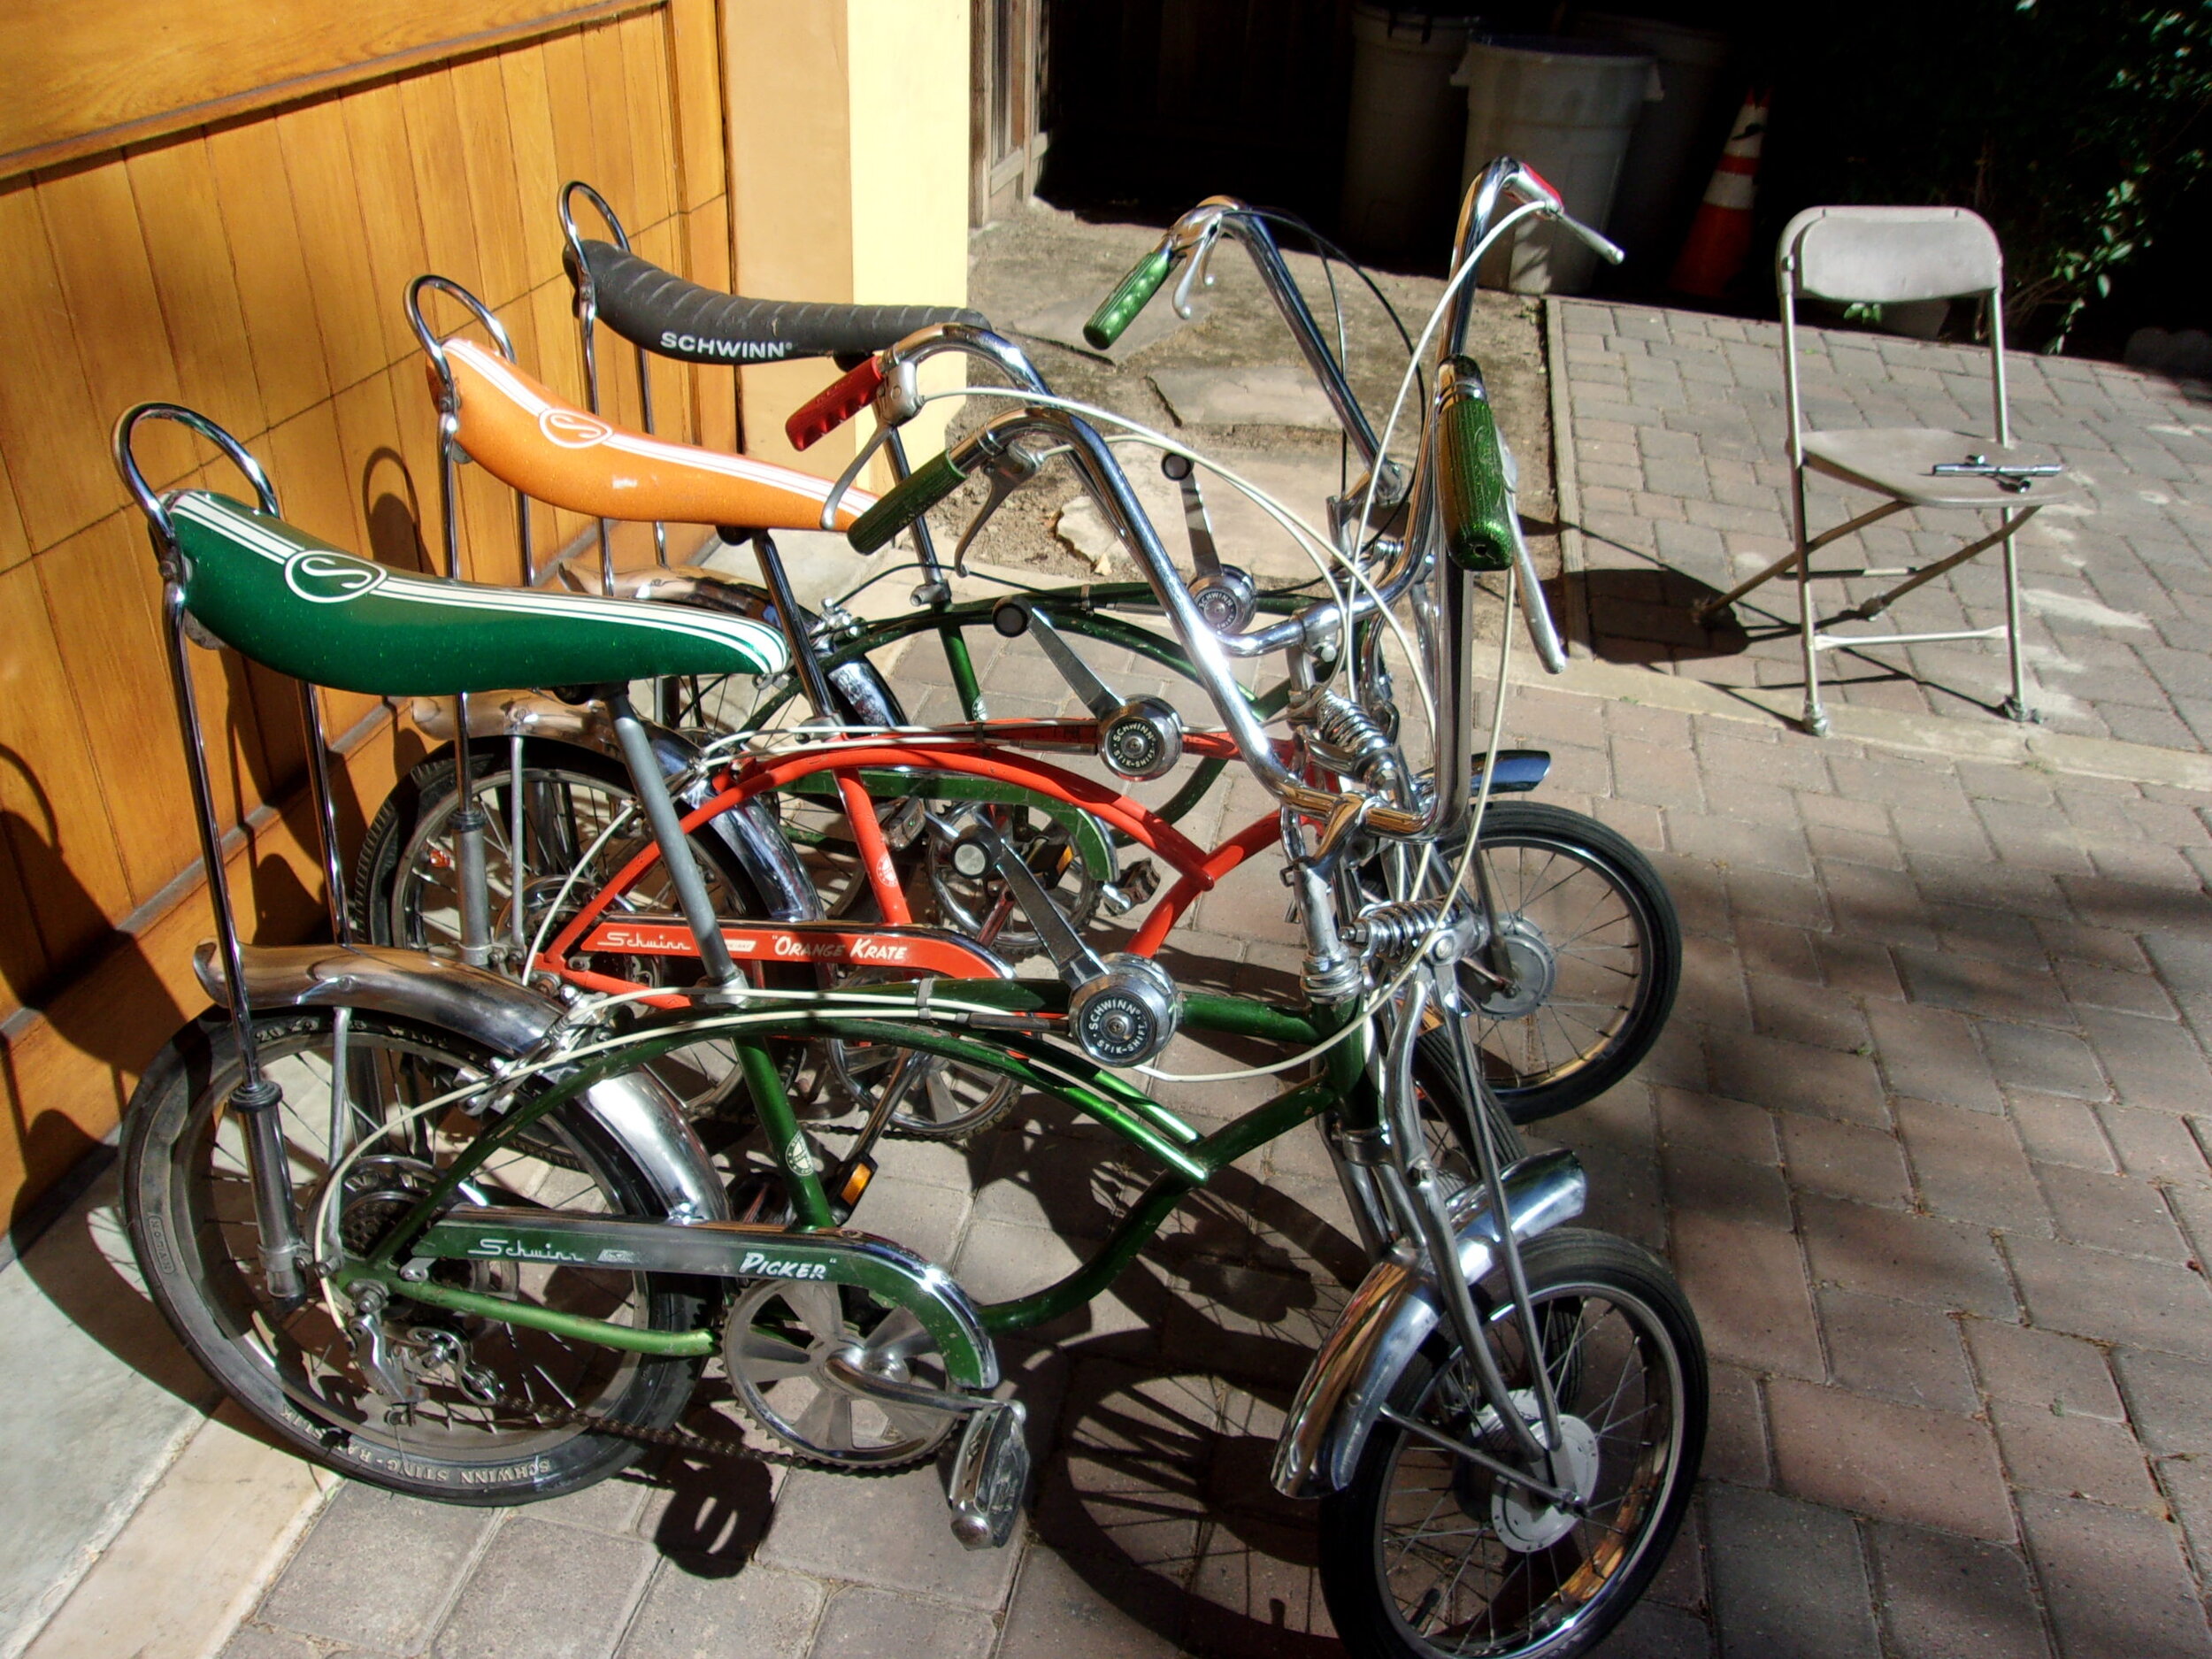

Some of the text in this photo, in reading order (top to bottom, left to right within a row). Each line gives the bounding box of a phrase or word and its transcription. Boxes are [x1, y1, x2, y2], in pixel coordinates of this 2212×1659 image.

[660, 331, 785, 358] SCHWINN
[1113, 722, 1156, 768] SCHWINN STIK-SHIFT
[597, 932, 691, 950] Schwinn
[849, 938, 908, 960] KRATE
[1088, 999, 1146, 1054] SCHWINN STIK-SHIFT
[467, 1239, 585, 1262] Schwinn
[334, 1443, 449, 1482] STING-RA
[460, 1460, 551, 1484] SCHWINN
